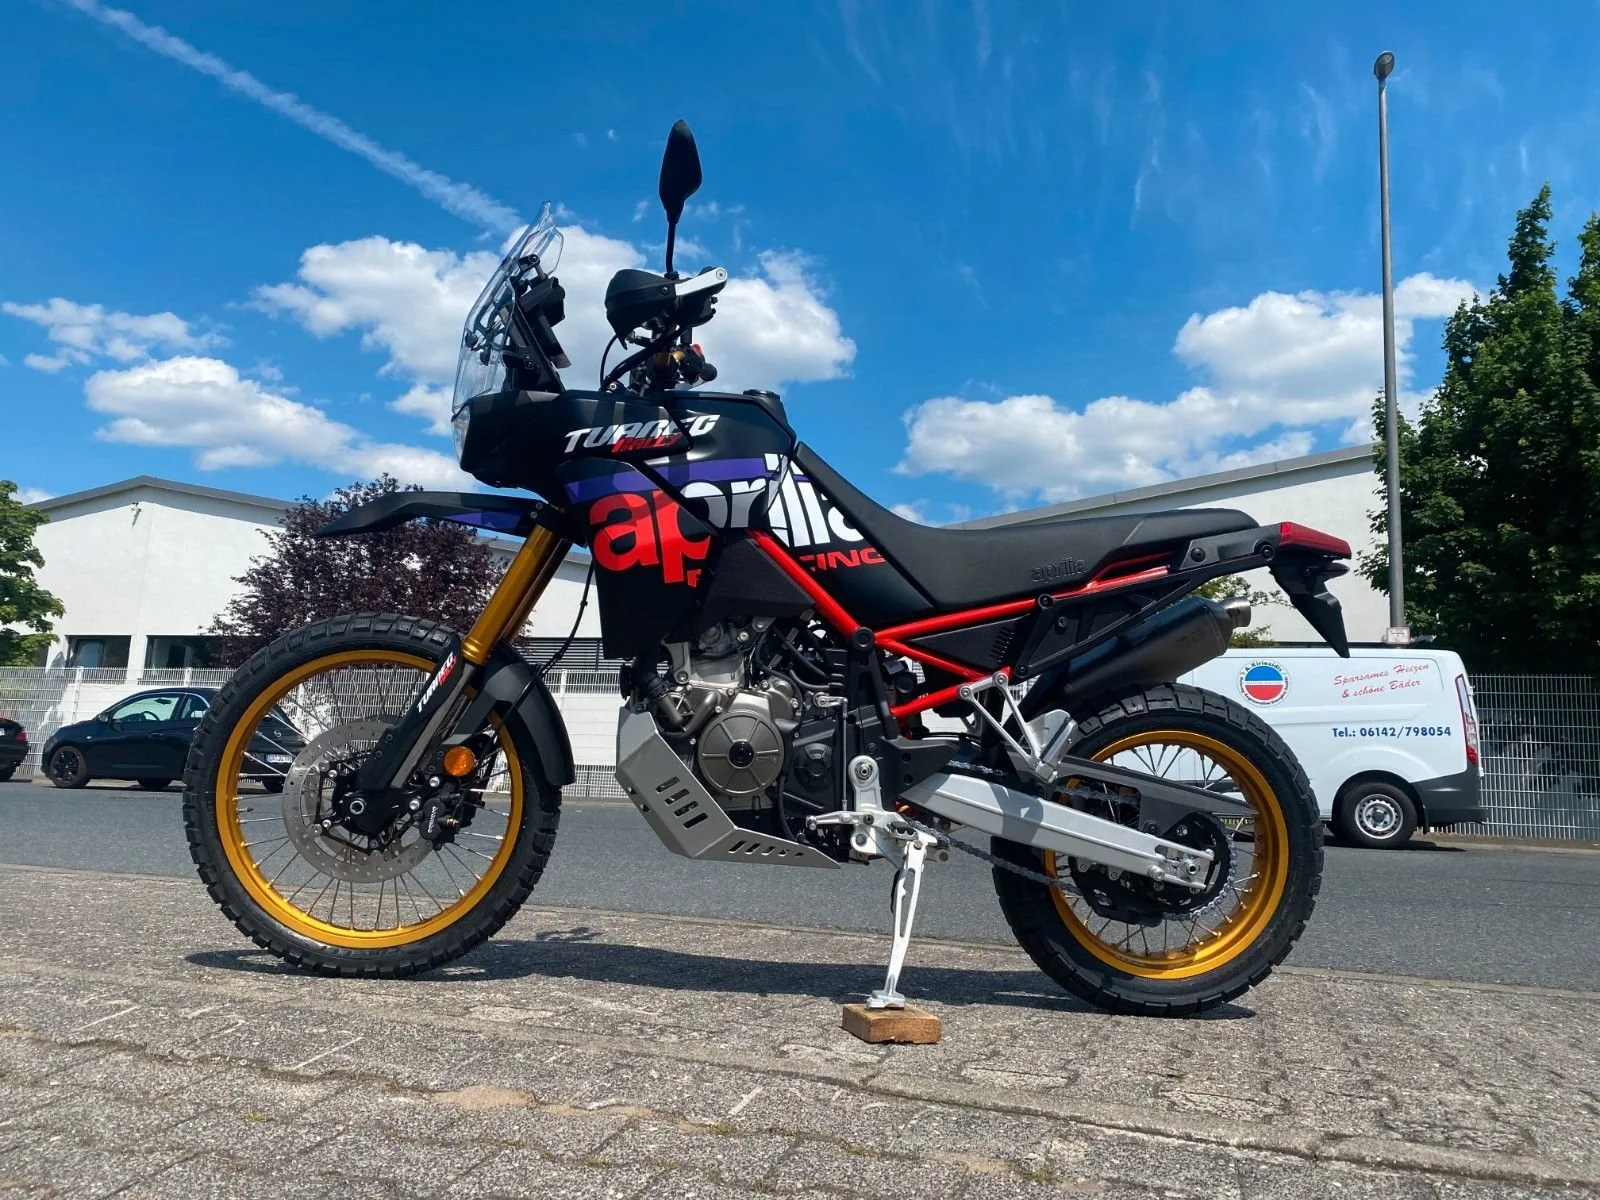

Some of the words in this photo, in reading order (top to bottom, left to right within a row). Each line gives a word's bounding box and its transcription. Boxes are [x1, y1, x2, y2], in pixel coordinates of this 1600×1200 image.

[1334, 669, 1389, 686] Sparsames
[1393, 663, 1431, 674] Heizen
[1341, 688, 1349, 698] &
[1352, 684, 1385, 697] schöne
[1332, 727, 1356, 738] Tel.:
[1359, 726, 1452, 739] 06142/798054
